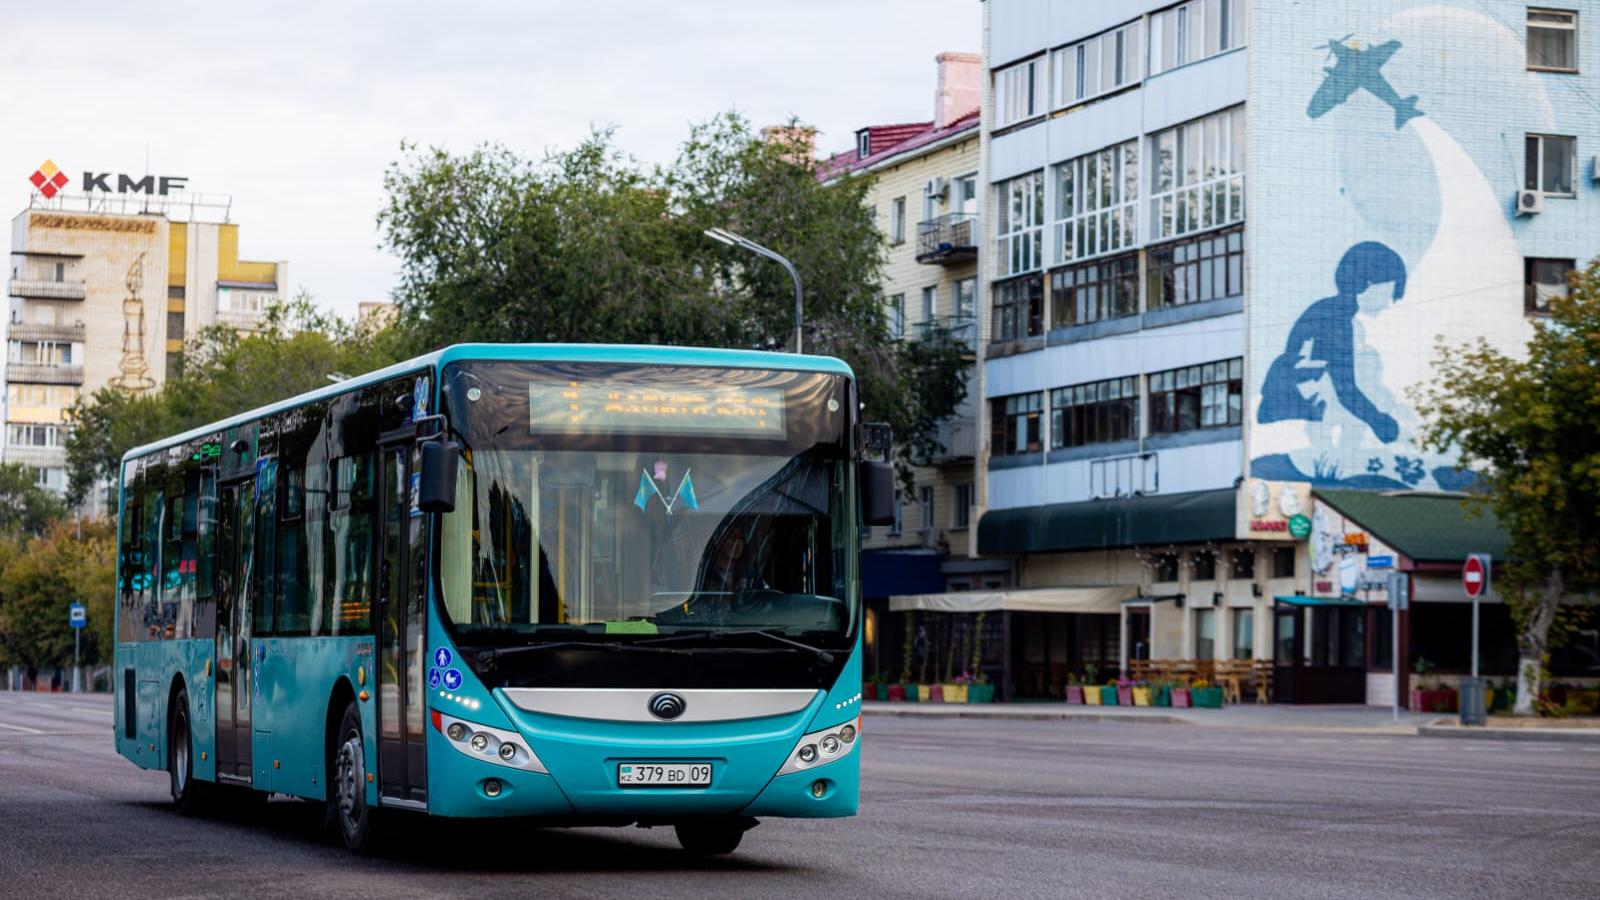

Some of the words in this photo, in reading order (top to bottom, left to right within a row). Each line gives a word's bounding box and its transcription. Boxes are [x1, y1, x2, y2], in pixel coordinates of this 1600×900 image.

[83, 172, 188, 195] KMF
[636, 767, 663, 781] 379
[668, 770, 685, 781] BD
[691, 767, 709, 781] 09
